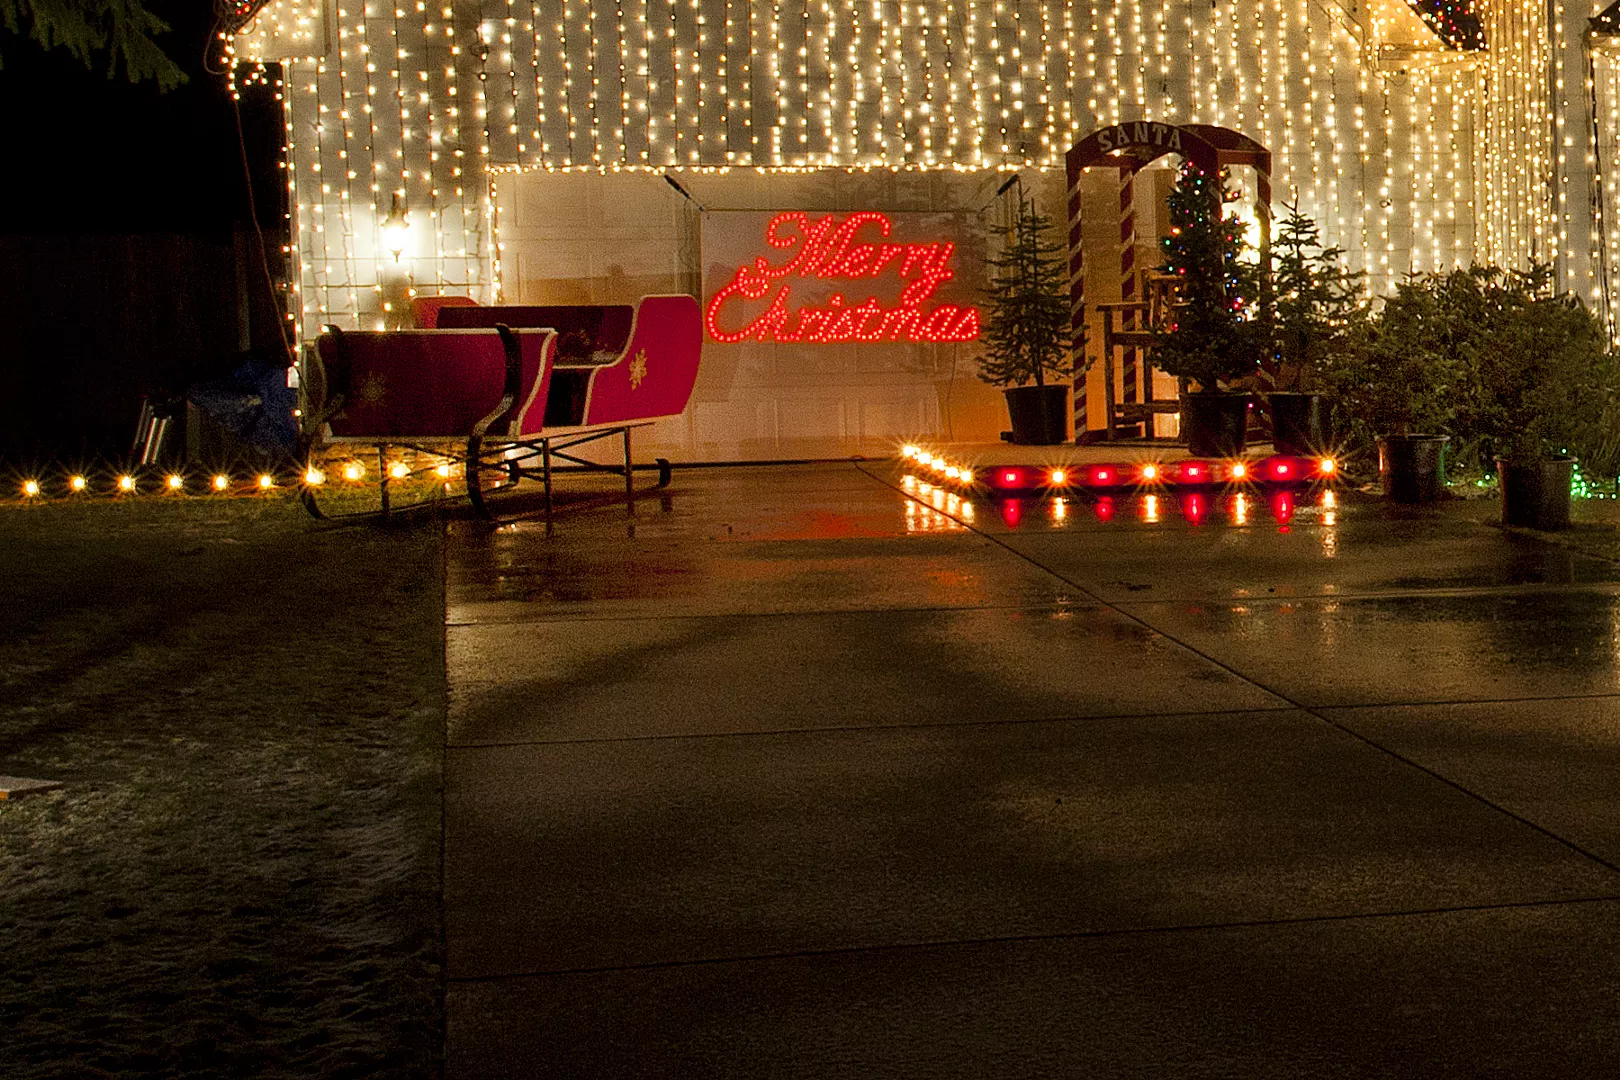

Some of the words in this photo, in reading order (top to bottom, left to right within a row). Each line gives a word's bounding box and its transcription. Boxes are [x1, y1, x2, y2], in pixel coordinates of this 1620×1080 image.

[1097, 122, 1182, 152] SANTA
[756, 211, 954, 306] Merry
[707, 266, 980, 343] Christmas
